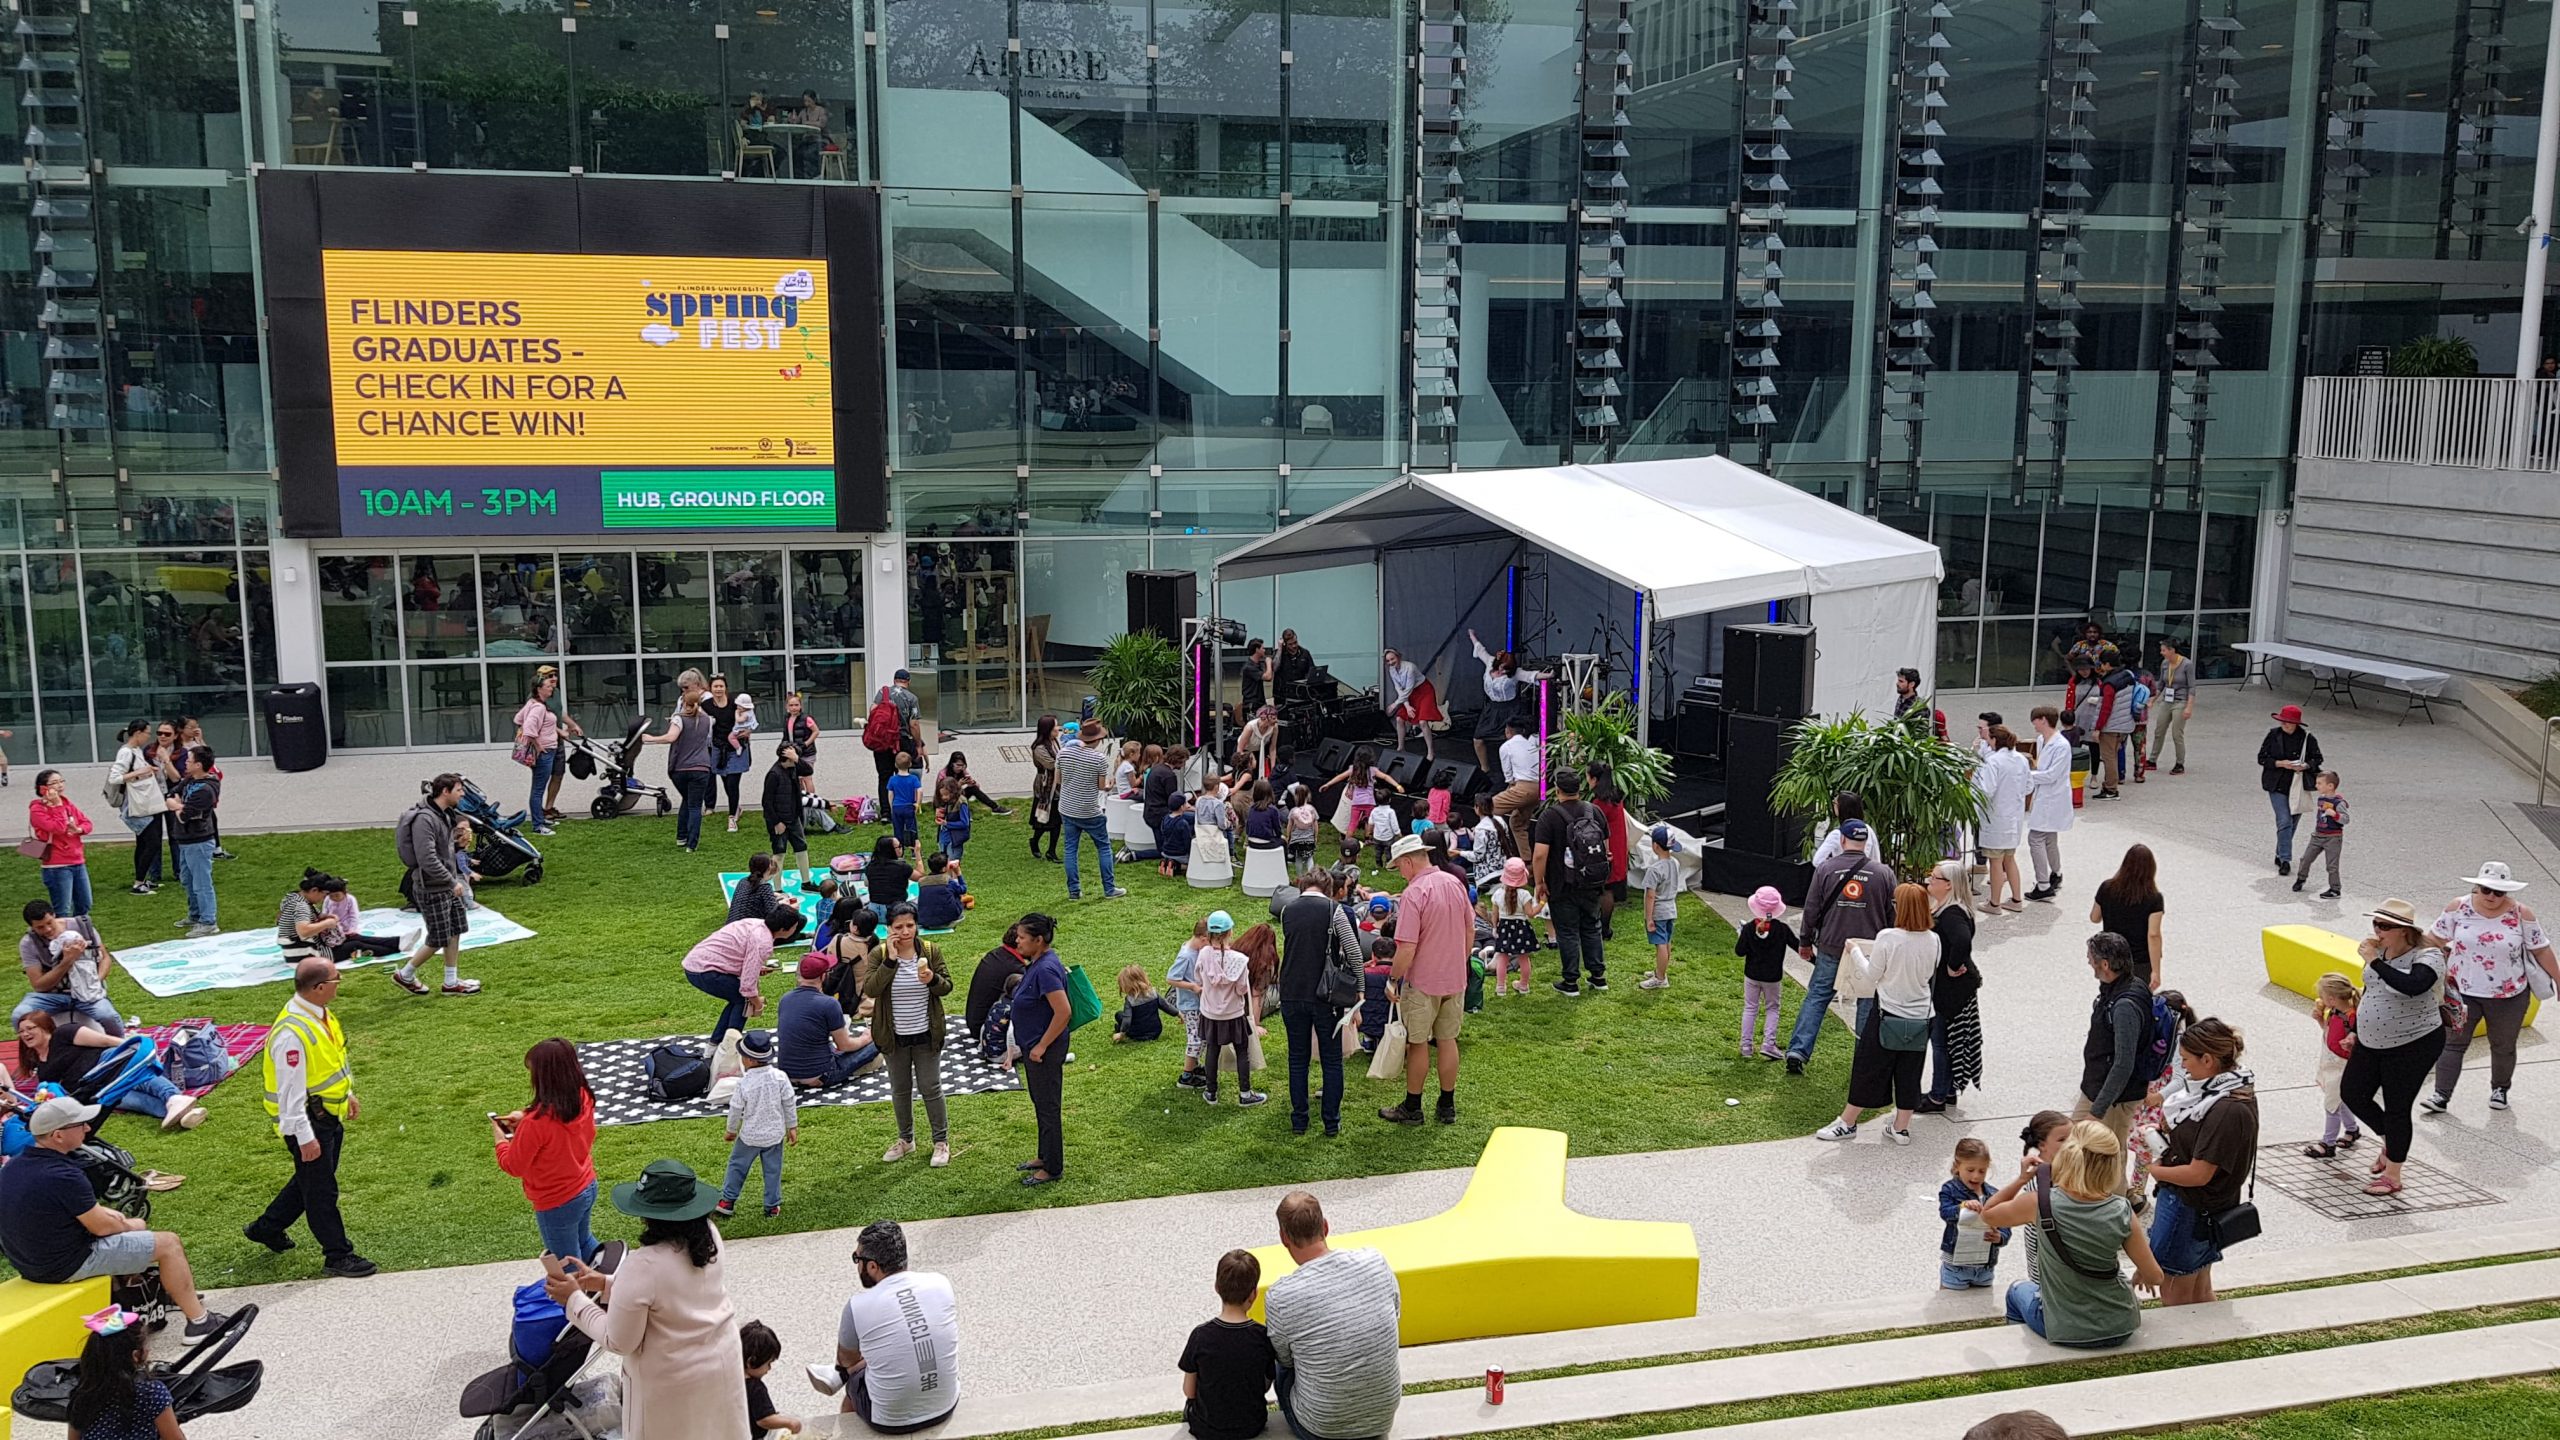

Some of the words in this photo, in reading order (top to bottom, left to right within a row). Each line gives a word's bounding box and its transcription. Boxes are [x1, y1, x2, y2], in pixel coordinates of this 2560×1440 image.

[995, 86, 1041, 98] funtion
[1046, 88, 1081, 100] centre
[351, 299, 522, 327] FLINDERS
[645, 291, 798, 328] spring
[699, 319, 785, 349] FEST
[353, 336, 562, 364] GRADUATES
[355, 373, 472, 400] CHECK
[482, 374, 514, 400] IN
[527, 374, 595, 400] FOR
[604, 375, 627, 400] A
[357, 410, 500, 436] CHANCE
[509, 411, 585, 436] WIN!
[360, 489, 452, 516] 10AM
[482, 489, 557, 516] 3PM
[618, 491, 665, 510] HUB,
[670, 490, 756, 507] GROUND
[761, 490, 825, 507] FLOOR
[896, 1288, 931, 1342] CONNECT
